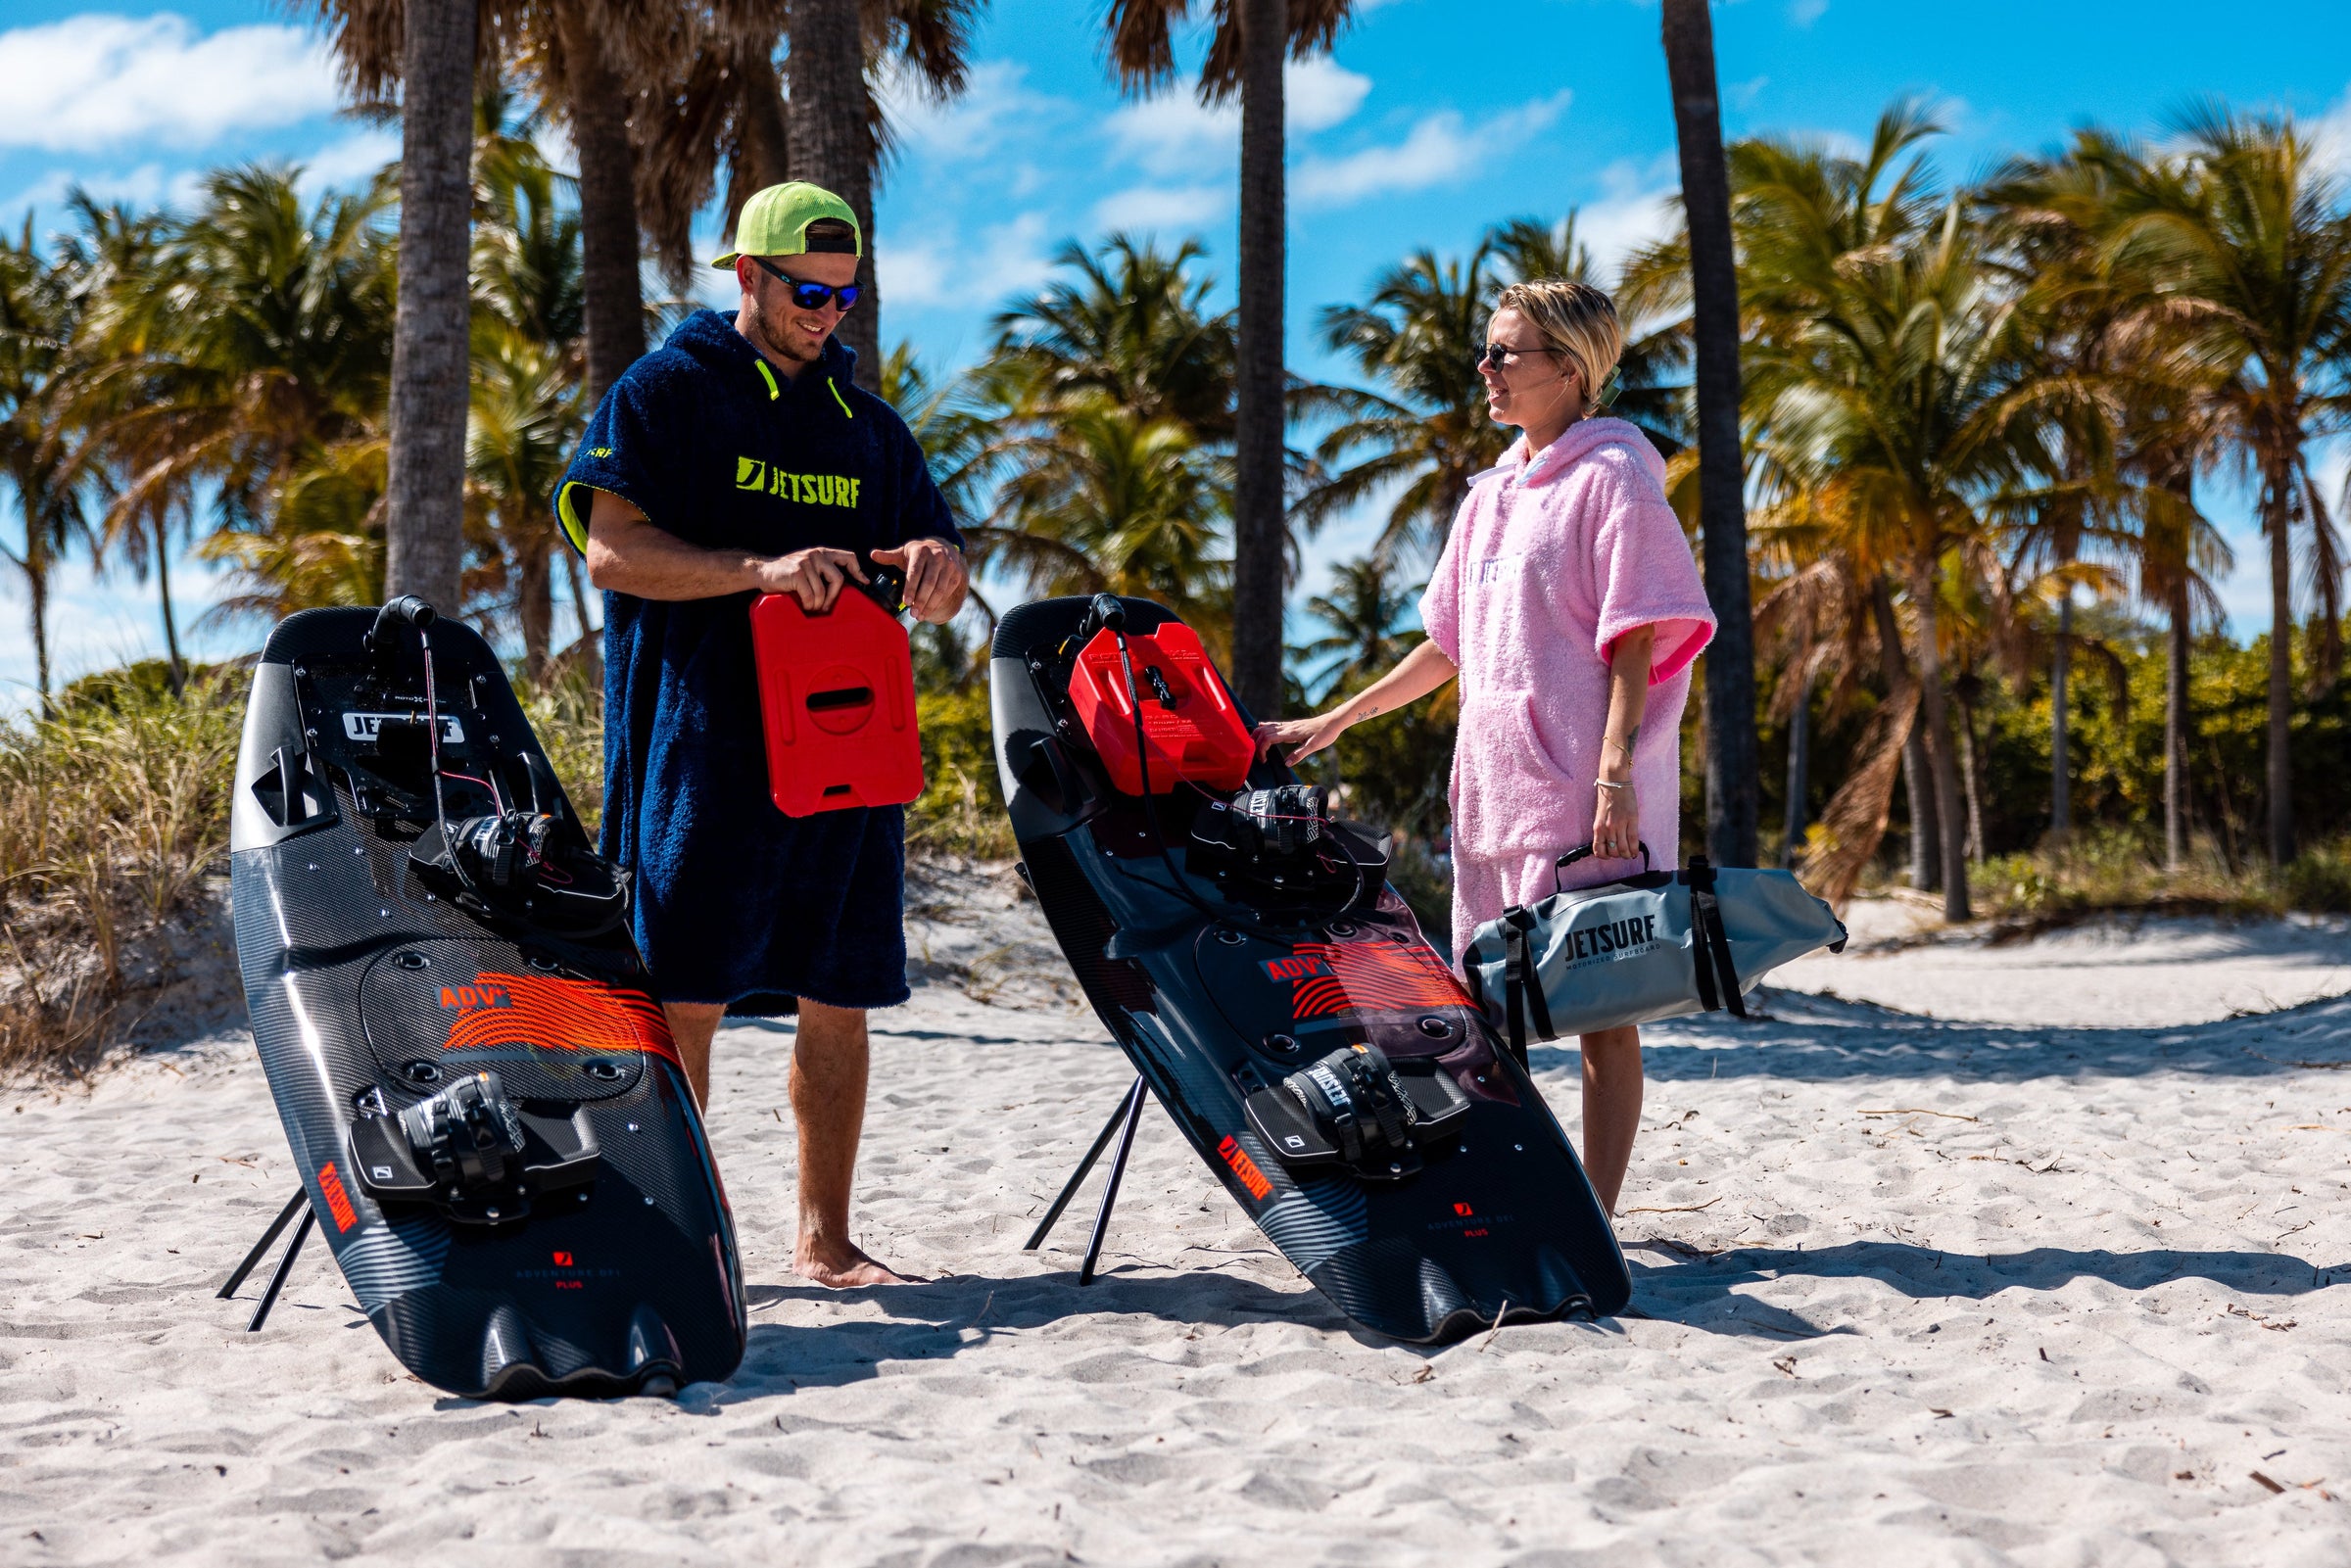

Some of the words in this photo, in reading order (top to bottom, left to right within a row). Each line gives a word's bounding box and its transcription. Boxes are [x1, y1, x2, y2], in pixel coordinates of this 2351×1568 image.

[769, 466, 860, 508] JETSURF
[1564, 914, 1655, 963] JETSURF
[1566, 956, 1610, 971] MOTORIZED
[1613, 943, 1660, 960] SURFBOARD
[1227, 1148, 1273, 1201] JETSURF
[1463, 1228, 1488, 1238] PLUS
[555, 1280, 583, 1289] PLUS
